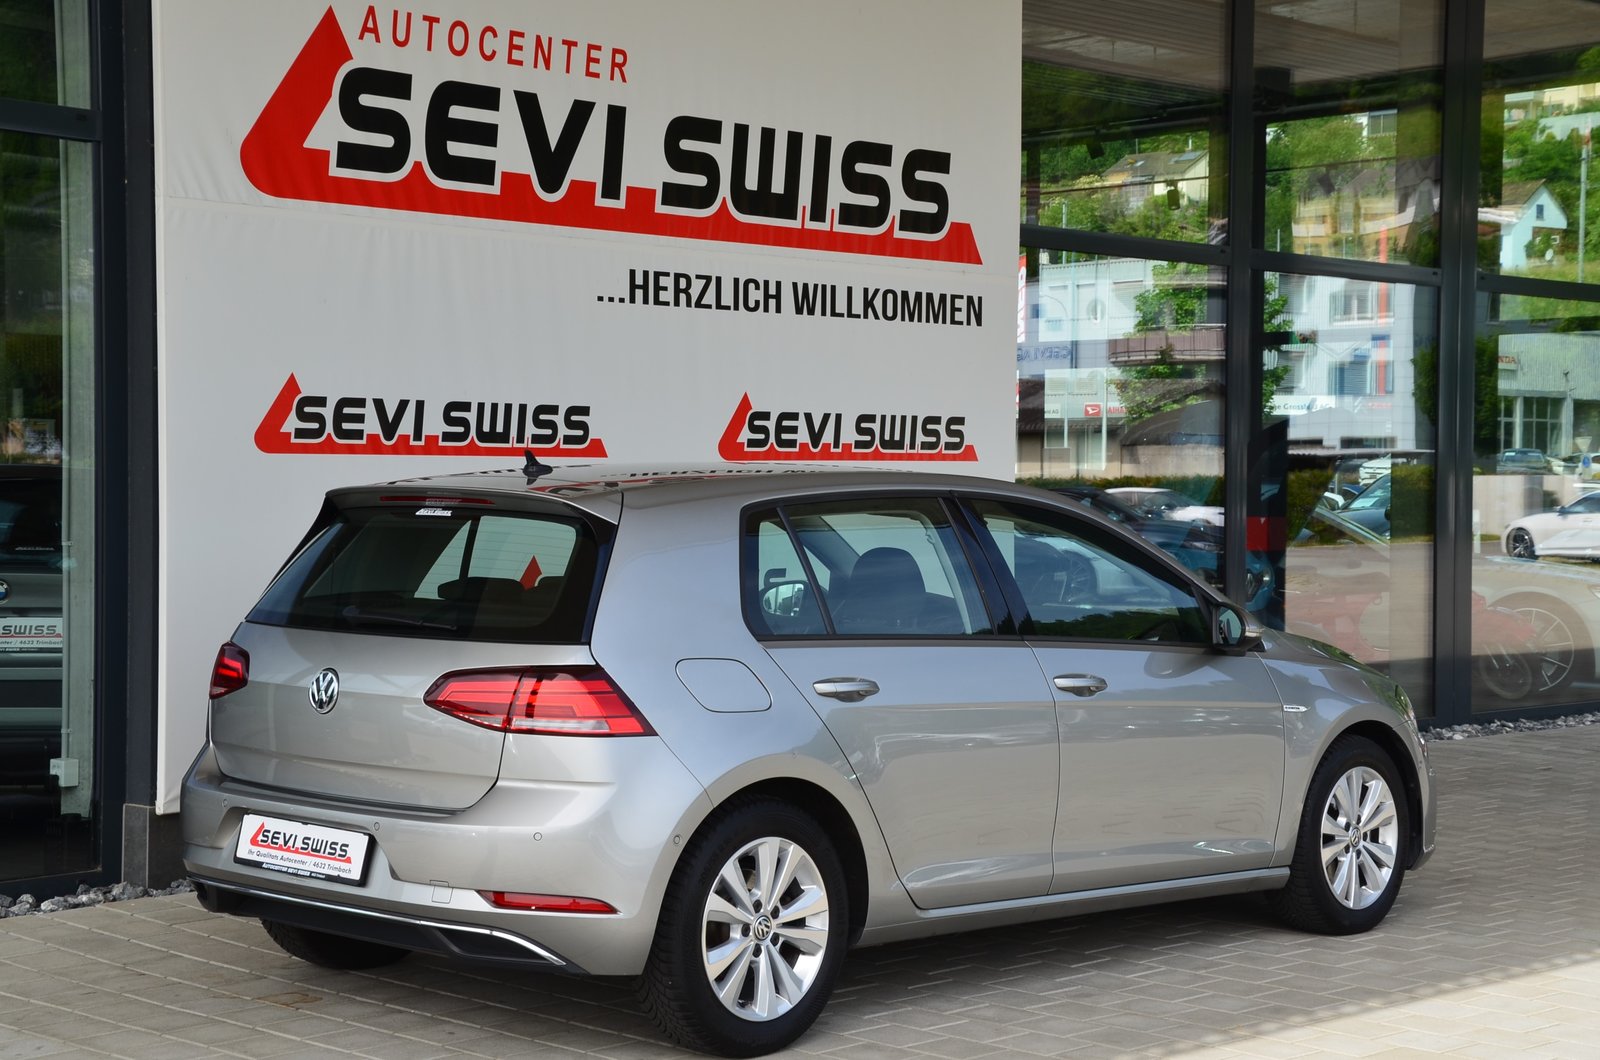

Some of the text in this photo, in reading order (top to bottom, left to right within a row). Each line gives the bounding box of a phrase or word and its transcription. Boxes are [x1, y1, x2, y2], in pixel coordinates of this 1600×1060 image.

[358, 4, 629, 84] AUTOCENTER
[336, 66, 952, 235] SEVI SWISS
[597, 268, 782, 314] ...HERZLICH
[792, 281, 983, 327] WILLKOMMEN
[294, 395, 591, 446] SEVI SWISS
[746, 410, 966, 451] SEVI SWISS
[1, 624, 57, 636] SWISS
[259, 829, 350, 858] SEVI SWISS
[279, 855, 308, 866] Autocenter
[312, 861, 326, 870] 4632
[327, 863, 352, 874] Trimbach
